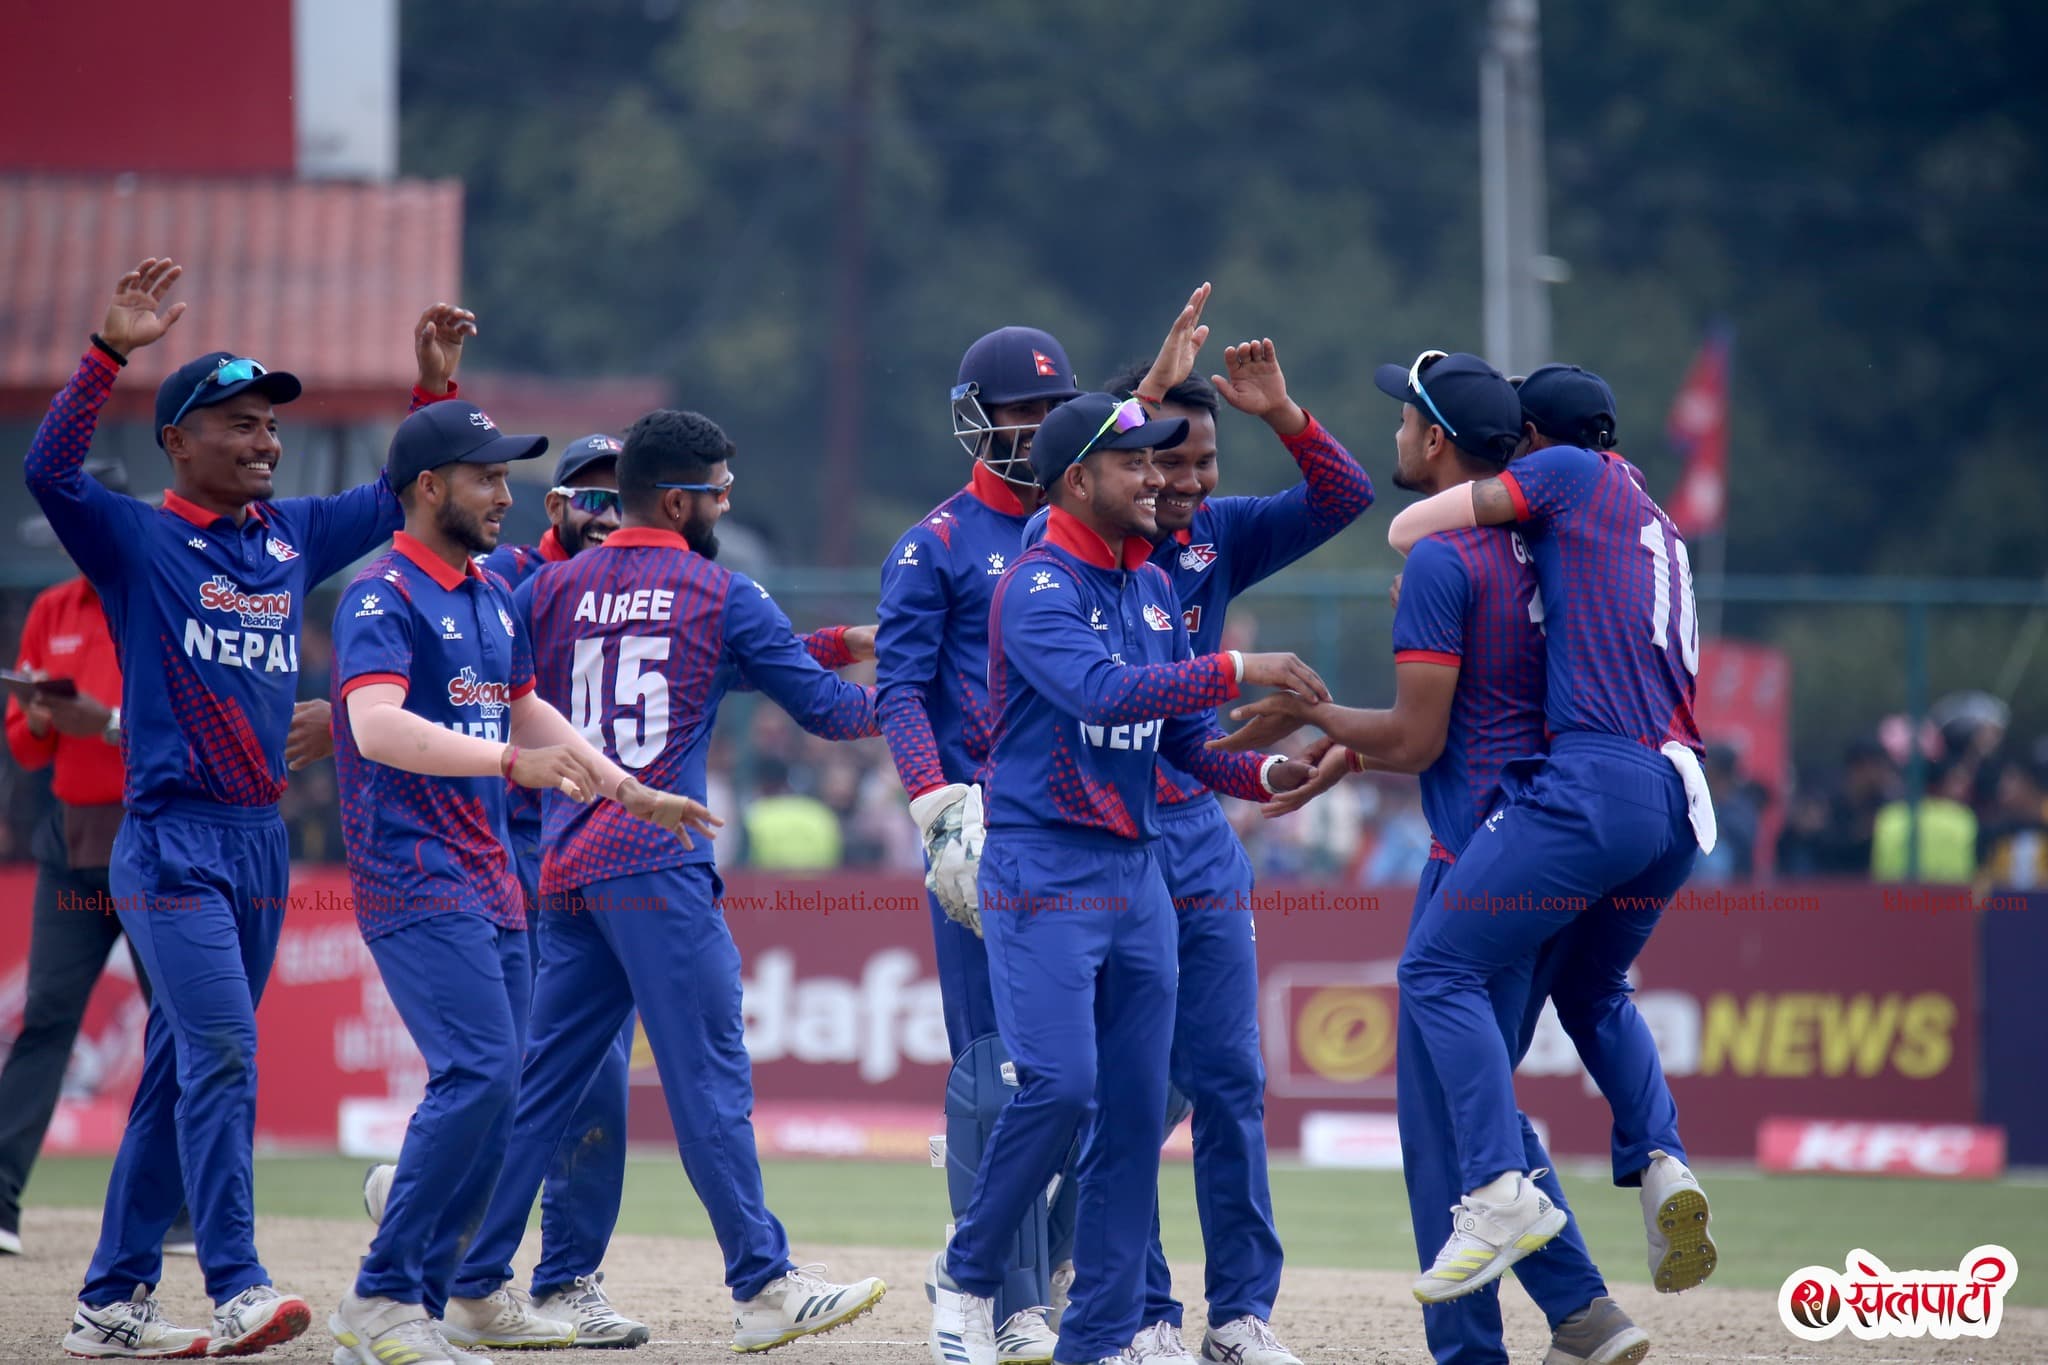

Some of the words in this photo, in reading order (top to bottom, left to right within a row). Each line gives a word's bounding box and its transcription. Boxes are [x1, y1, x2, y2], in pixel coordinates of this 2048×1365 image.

[200, 582, 291, 618] Second
[212, 575, 237, 593] My
[1029, 583, 1061, 594] KELME
[240, 613, 282, 629] Teacher
[355, 609, 384, 618] KELME
[574, 589, 675, 624] AIREE
[571, 635, 671, 769] 45
[1079, 718, 1164, 753] NEP
[742, 949, 953, 1083] dafa
[1700, 992, 1958, 1080] NEWS
[1790, 1122, 1977, 1175] KFC
